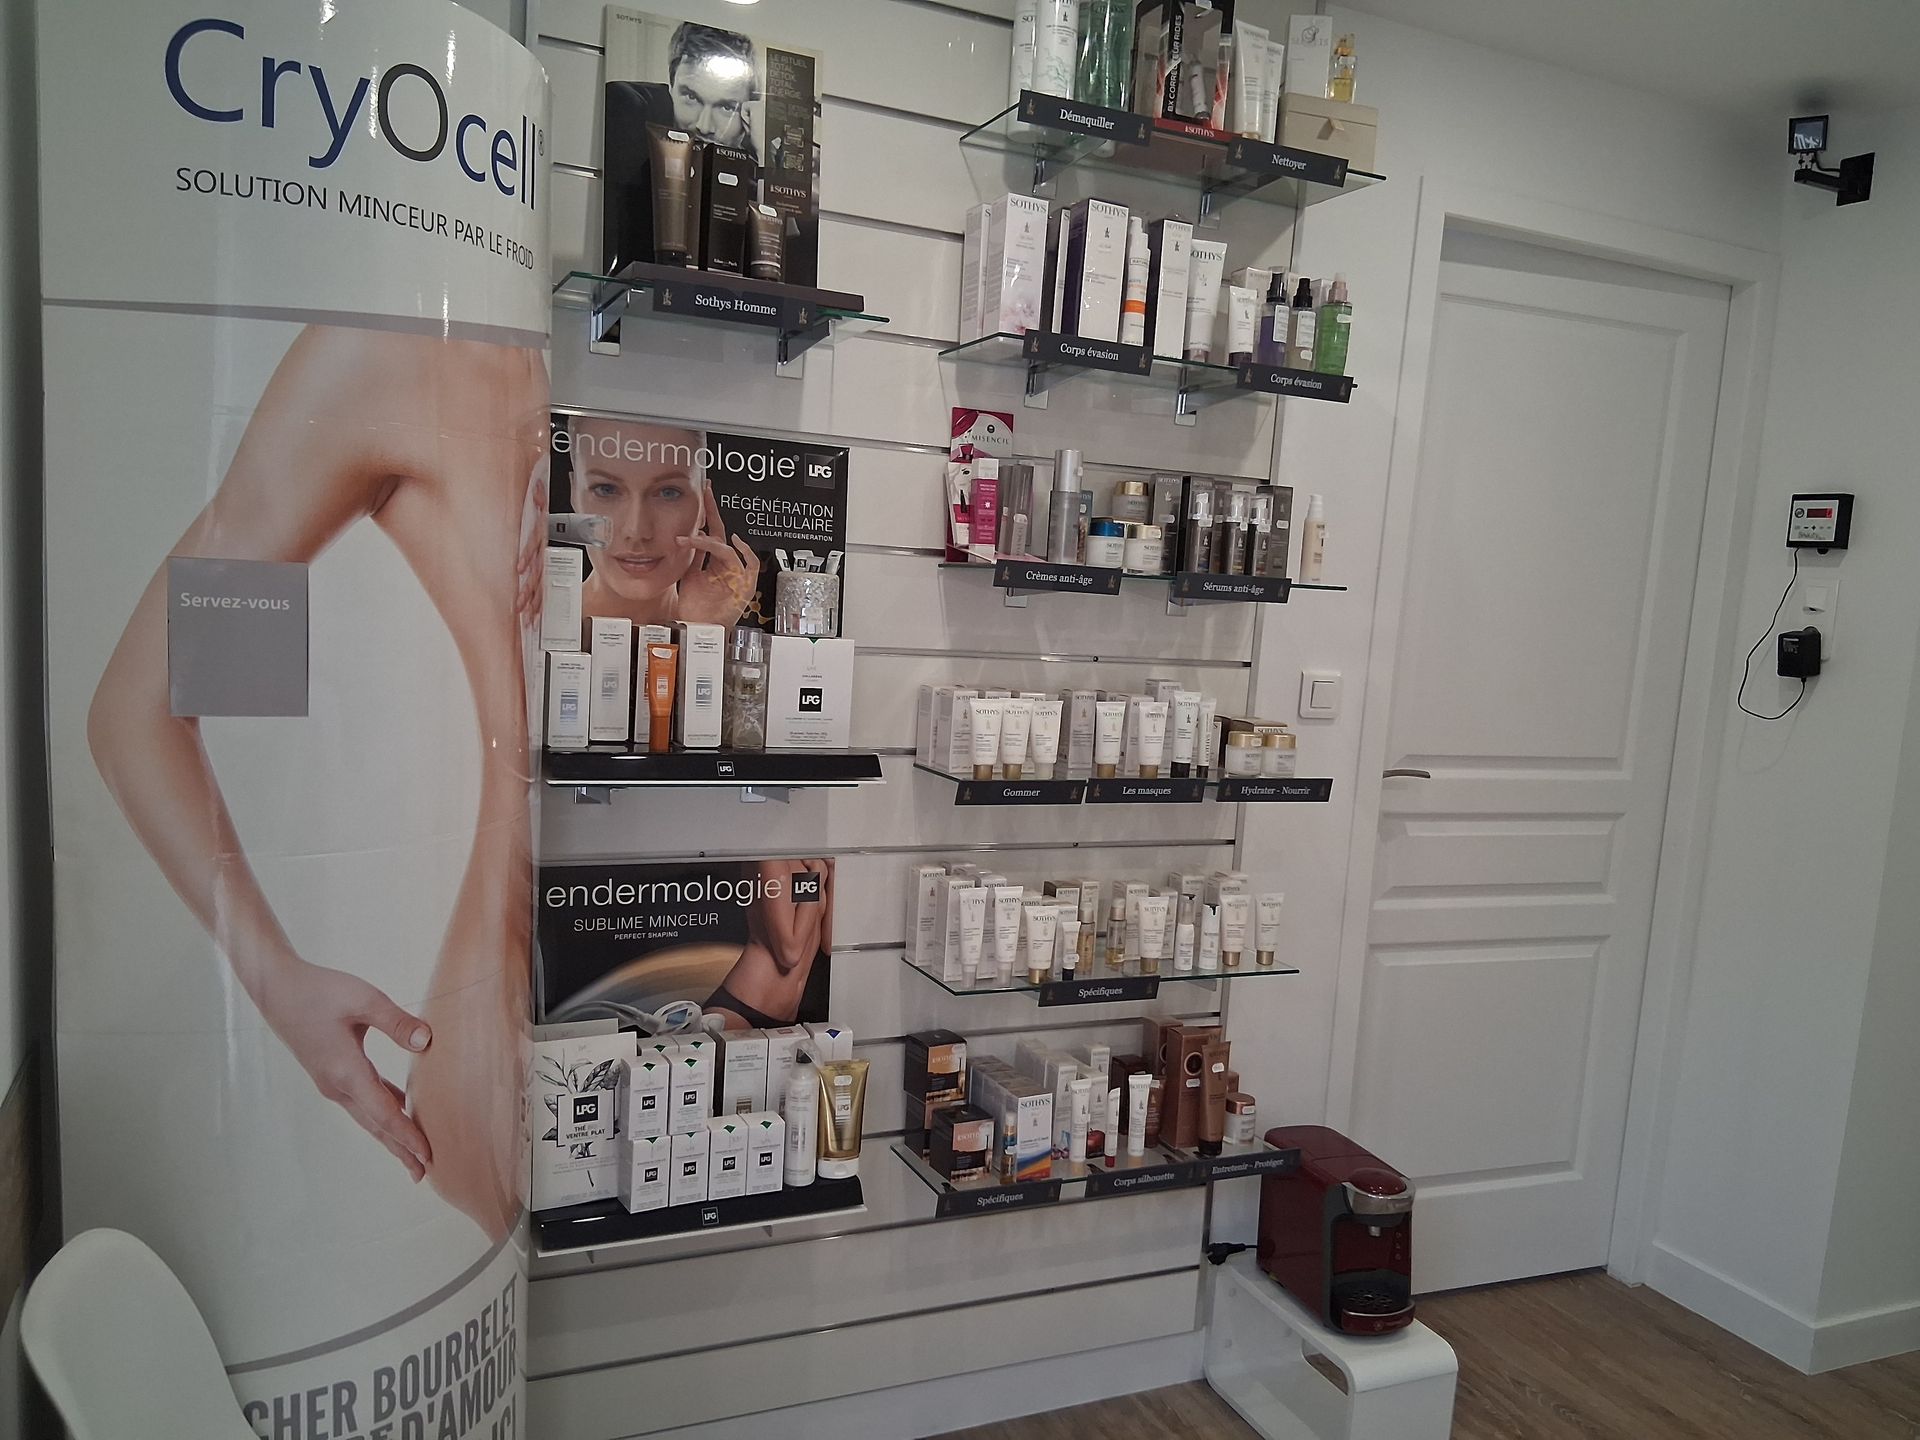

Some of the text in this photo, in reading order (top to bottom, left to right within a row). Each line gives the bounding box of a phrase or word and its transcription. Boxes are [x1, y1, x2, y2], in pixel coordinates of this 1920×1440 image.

[1059, 109, 1114, 131] Démaquiller
[720, 149, 747, 161] SOTHYS
[1272, 154, 1307, 170] Nettoyer
[773, 185, 807, 198] SOTHYS
[1010, 198, 1047, 213] SOTHYS
[1091, 202, 1127, 217] SOTHYS
[176, 167, 535, 270] SOLUTION MINCEUR PAR LE FROID
[695, 294, 777, 316] Sothys Homme
[1060, 343, 1119, 361] Corps évasion
[1270, 373, 1322, 389] Corps évasion
[808, 464, 833, 479] LPG
[720, 493, 834, 519] RÉGÉNÉRATION
[745, 512, 833, 533] CELLULAIRE
[748, 529, 783, 538] CELLULAR
[1025, 570, 1093, 587] Crèmes anti-âge
[1203, 582, 1264, 596] Sérums anti-âge
[180, 592, 290, 610] Servez-vous
[801, 695, 820, 705] LPG
[1003, 788, 1041, 798] Gommer
[1122, 786, 1171, 798] Les masques
[1240, 786, 1275, 796] Hydrater
[1281, 787, 1311, 795] Nourrir
[546, 873, 818, 908] endermologie LPG
[573, 913, 720, 932] SUBLIME MINCEUR
[614, 930, 679, 940] PERFECT SHAPING
[1078, 987, 1123, 998] Spécifiques
[576, 1103, 596, 1116] LPG
[1020, 1098, 1050, 1108] SOTHYS
[1211, 1163, 1249, 1175] Entretenir
[1253, 1158, 1285, 1169] Protéger
[1113, 1172, 1175, 1187] Corps silhouette
[976, 1193, 1024, 1206] Spécifiques
[704, 1212, 716, 1221] LPG
[374, 1272, 518, 1424] BOURRELET
[401, 1328, 517, 1440] D'AMOUR
